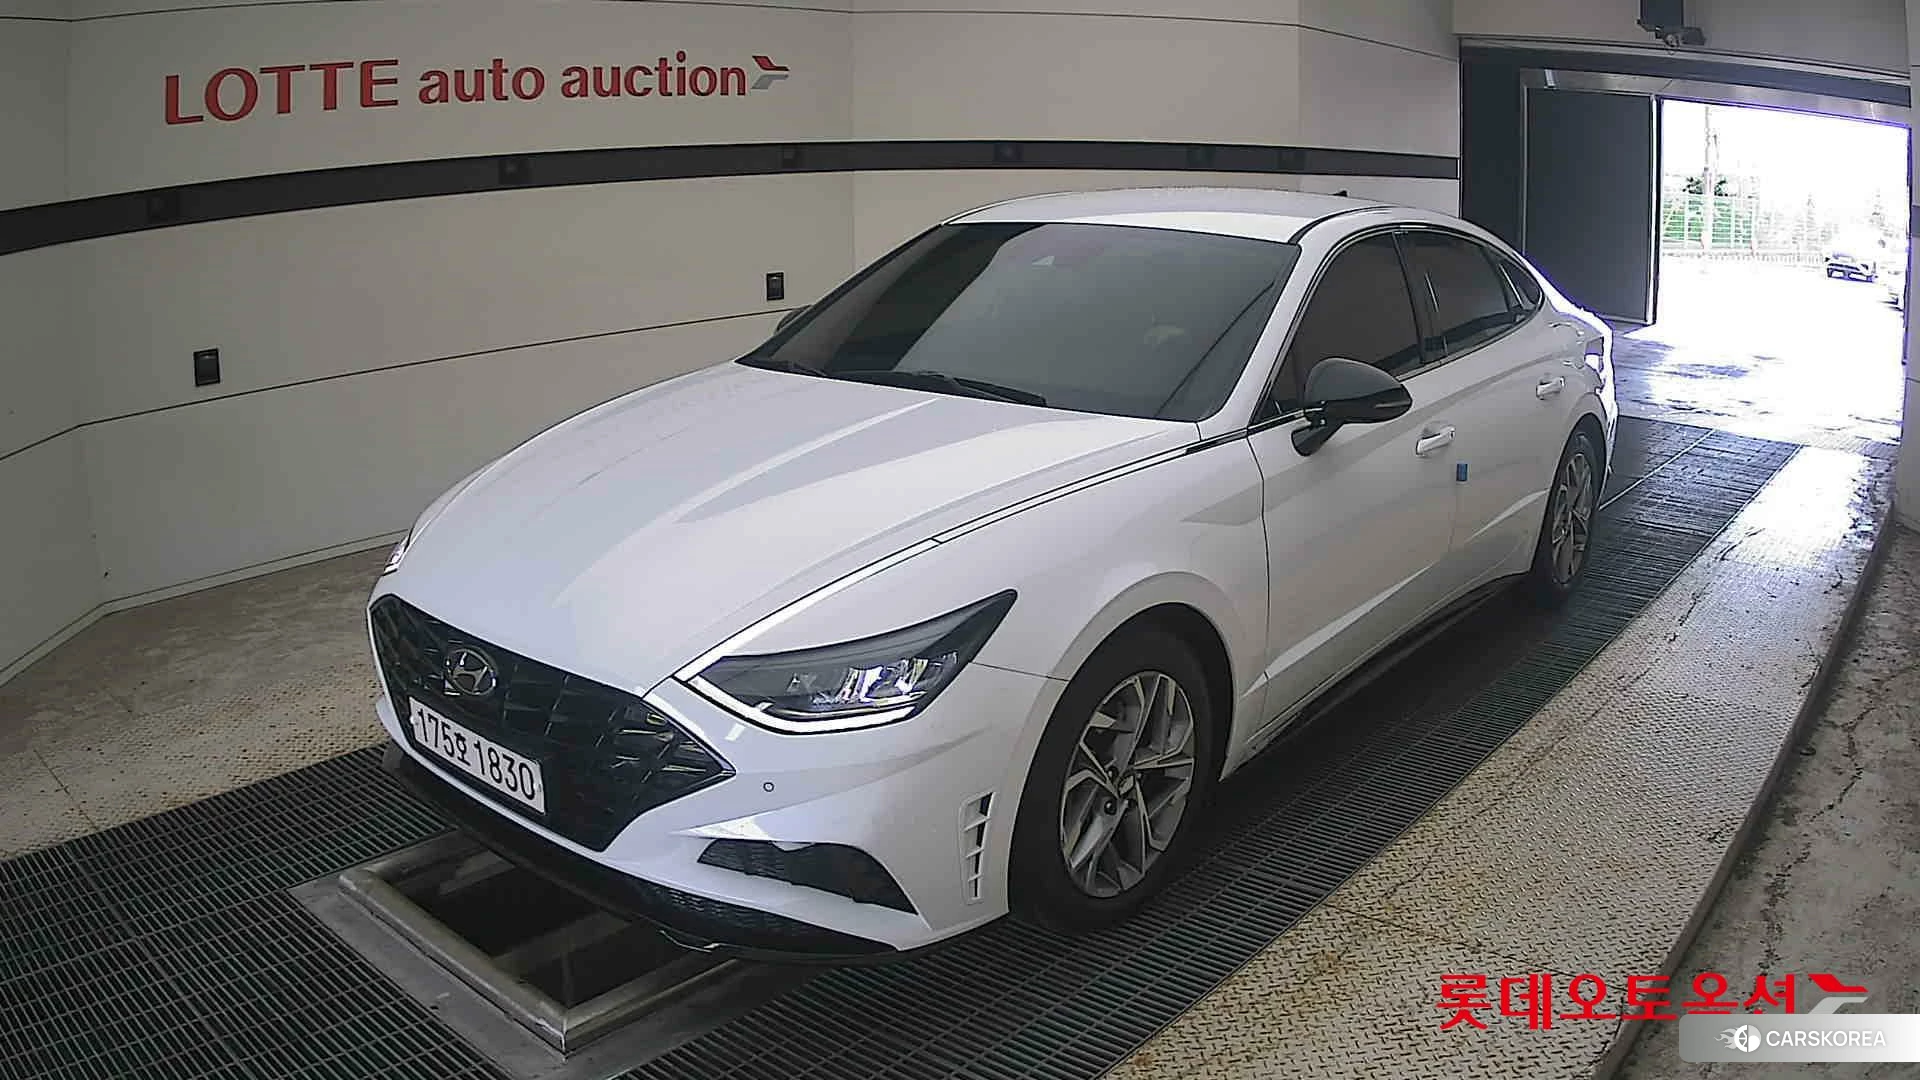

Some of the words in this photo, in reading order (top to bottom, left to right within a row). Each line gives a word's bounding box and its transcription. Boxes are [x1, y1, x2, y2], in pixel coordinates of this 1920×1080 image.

[164, 58, 399, 125] LOTTE
[418, 57, 545, 104] auto
[560, 50, 747, 97] auction
[474, 740, 535, 800] 1830
